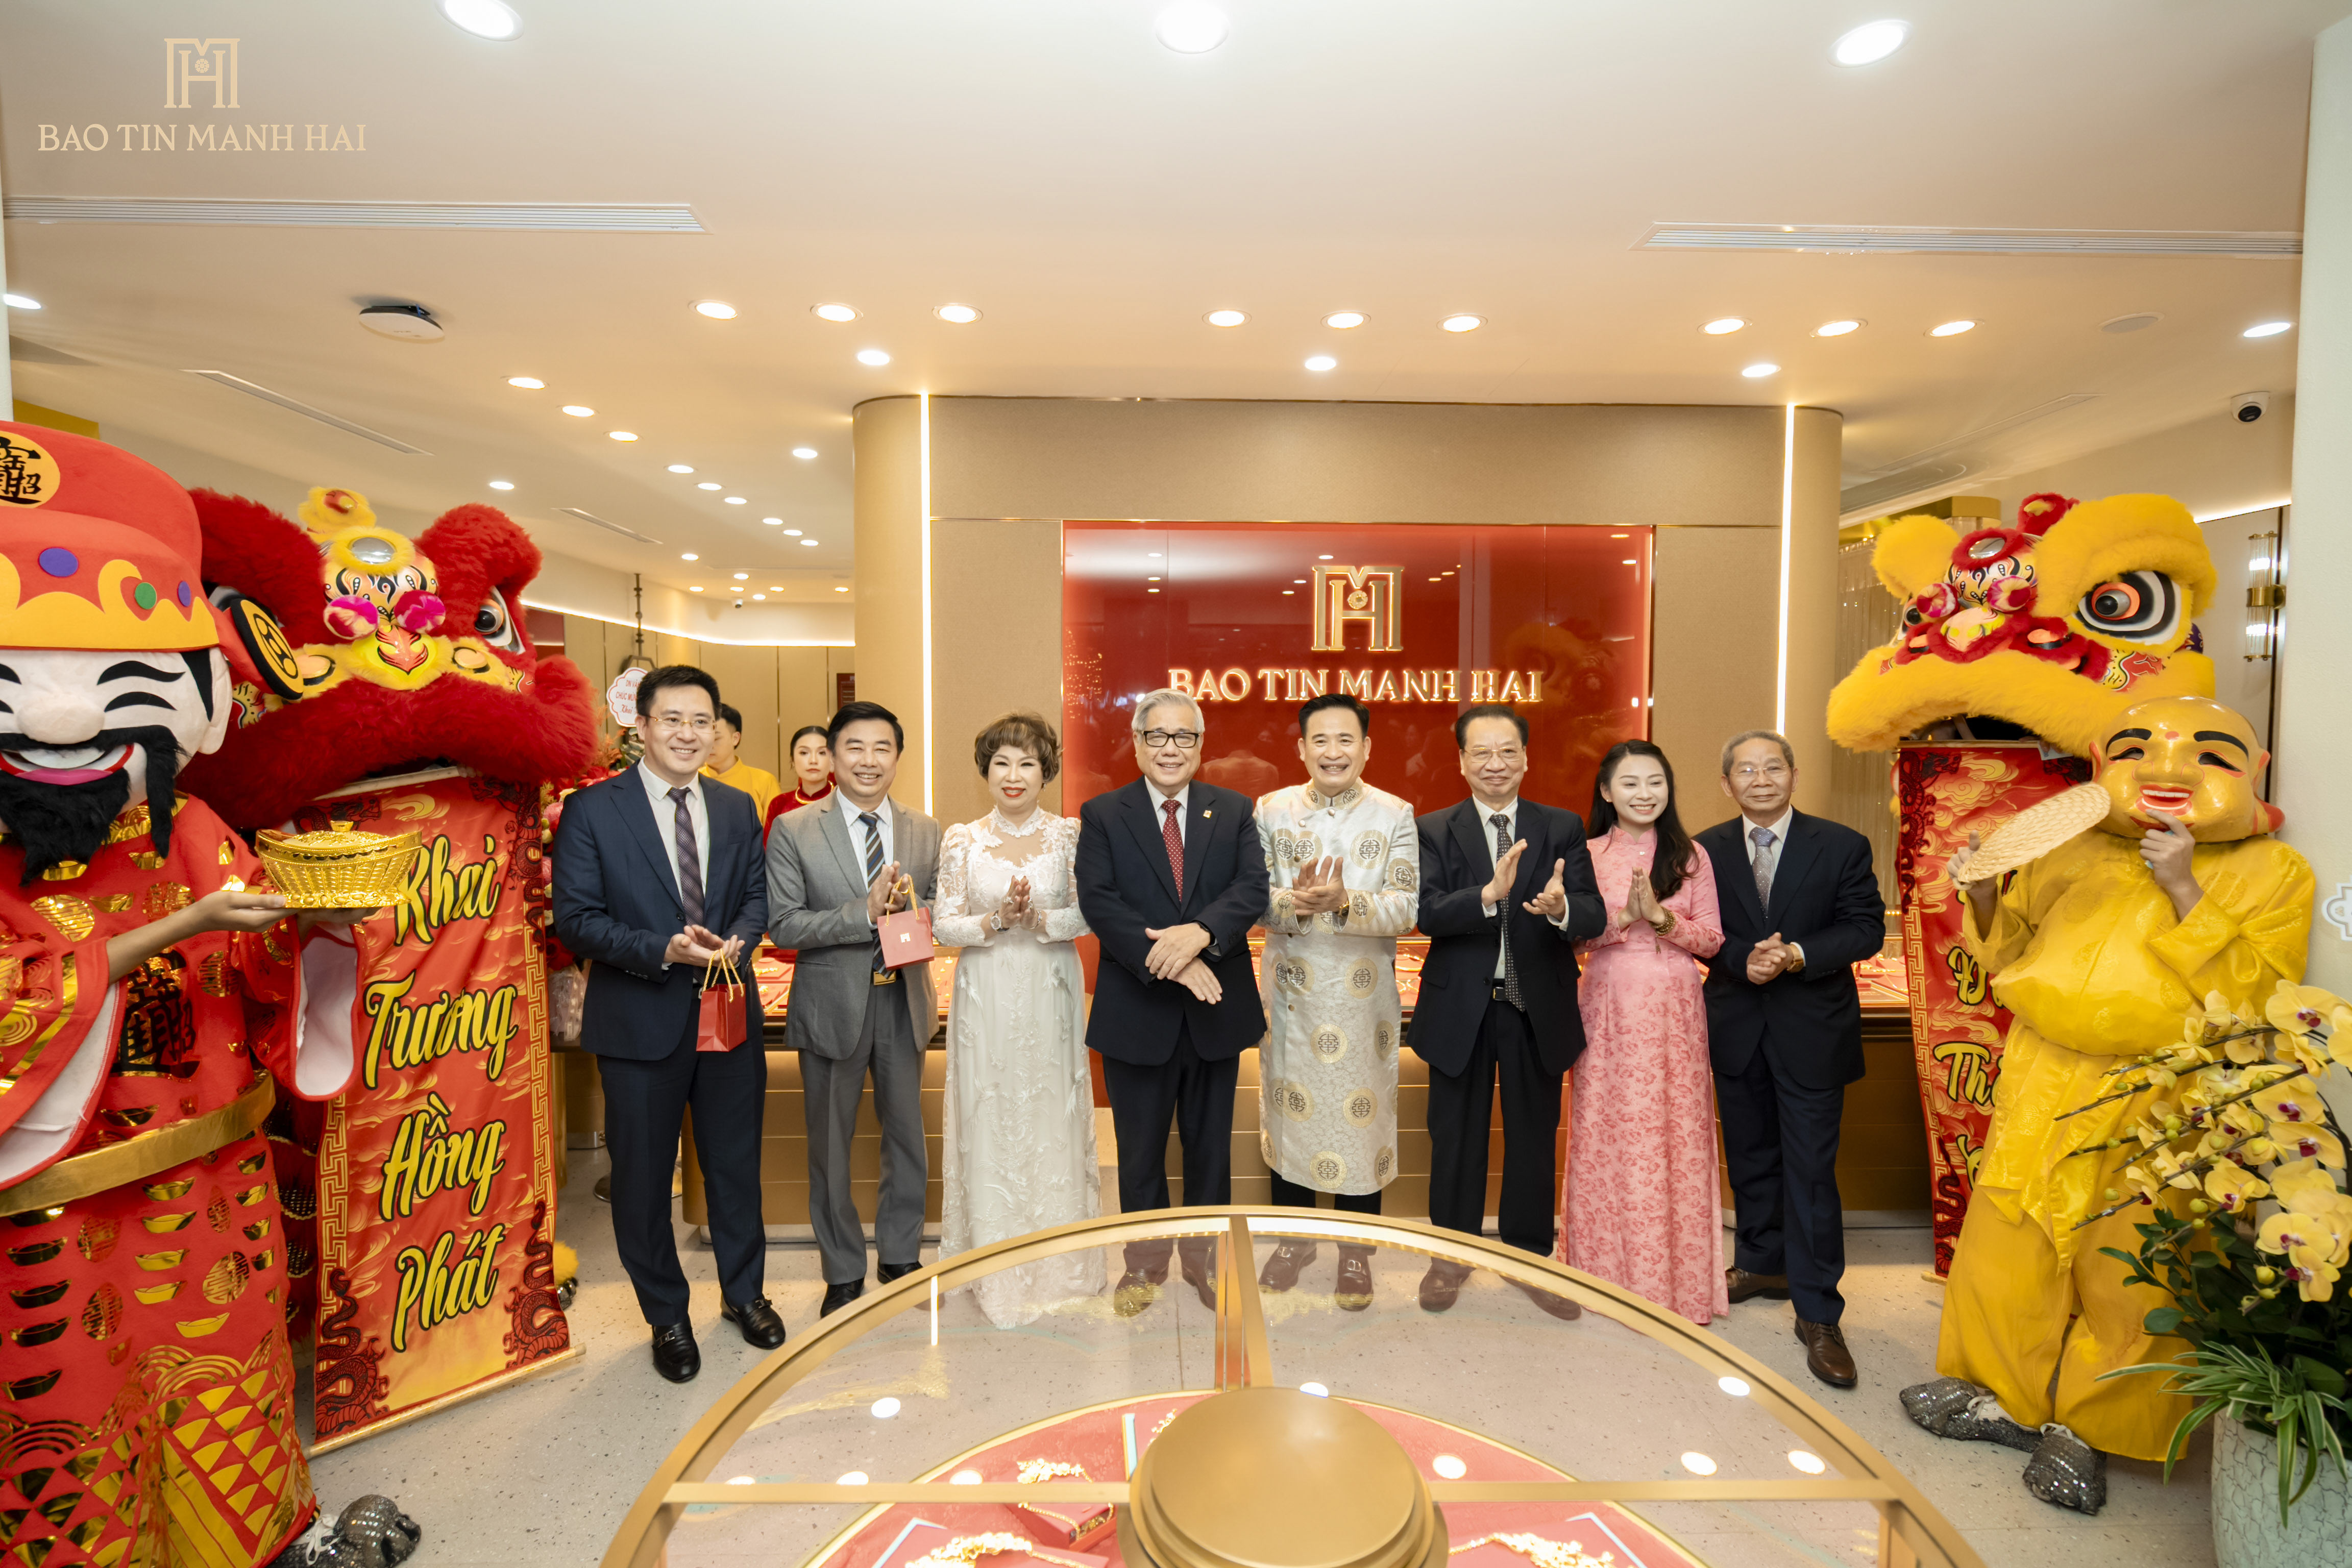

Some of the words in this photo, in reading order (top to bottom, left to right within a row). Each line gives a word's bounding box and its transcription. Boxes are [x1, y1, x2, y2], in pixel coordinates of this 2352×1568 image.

[1168, 668, 1251, 701] BAO
[1258, 669, 1329, 701] TIN
[1339, 669, 1462, 702] MANH
[1471, 670, 1544, 702] HAI
[394, 834, 501, 946] Khai
[379, 1091, 506, 1221] Hồng
[391, 1223, 506, 1353] Phát
